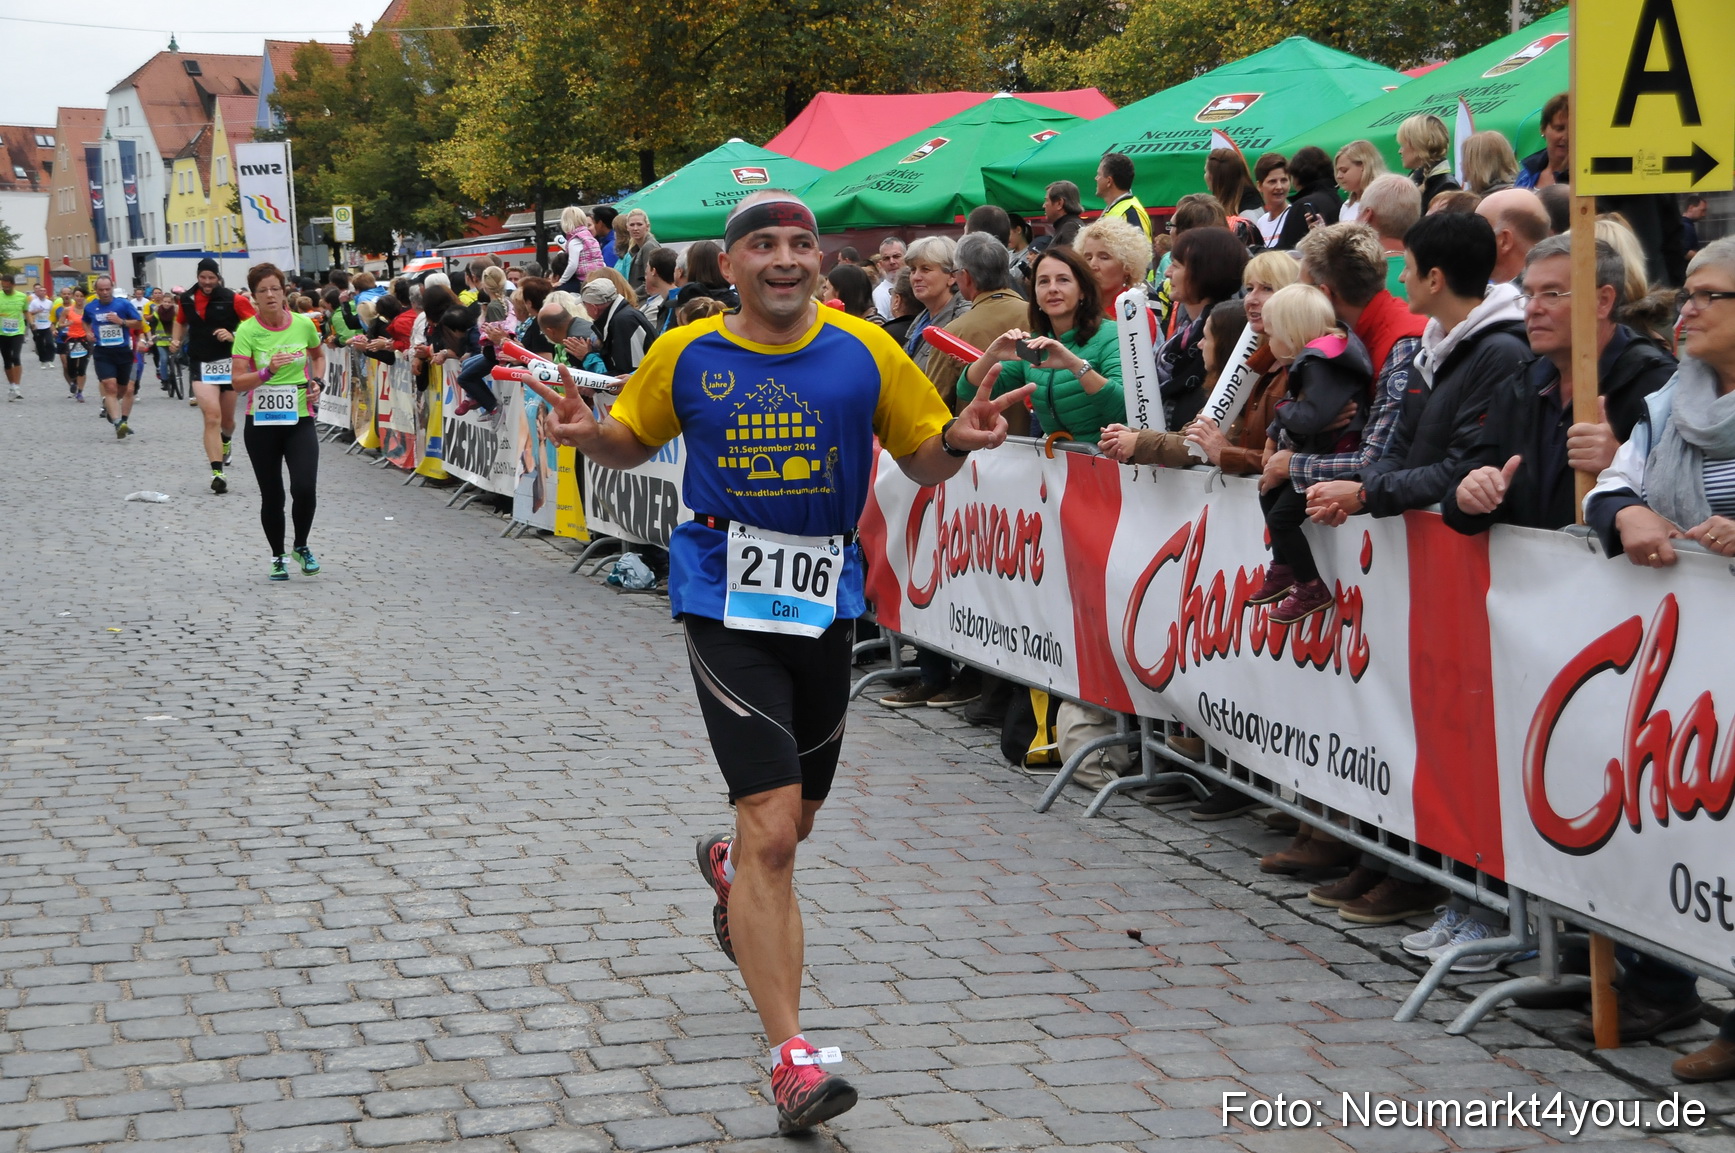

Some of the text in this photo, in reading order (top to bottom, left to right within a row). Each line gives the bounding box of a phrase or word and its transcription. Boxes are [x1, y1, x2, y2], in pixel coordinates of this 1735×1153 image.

[1612, 0, 1702, 127] A
[1102, 136, 1272, 156] Lammsäu
[205, 364, 230, 374] 2834
[557, 373, 611, 389] BW Lauf
[708, 381, 728, 389] Jahre
[258, 394, 294, 410] 2803
[729, 443, 816, 454] 21.September 2014
[906, 459, 1045, 609] Charivari
[740, 545, 832, 598] 2106
[771, 600, 799, 618] Can
[1122, 503, 1370, 693] Charivari
[949, 602, 1063, 668] Ostbayerns Radio
[1522, 592, 1735, 856] Cha
[1198, 692, 1391, 796] Ostbayerns Radio
